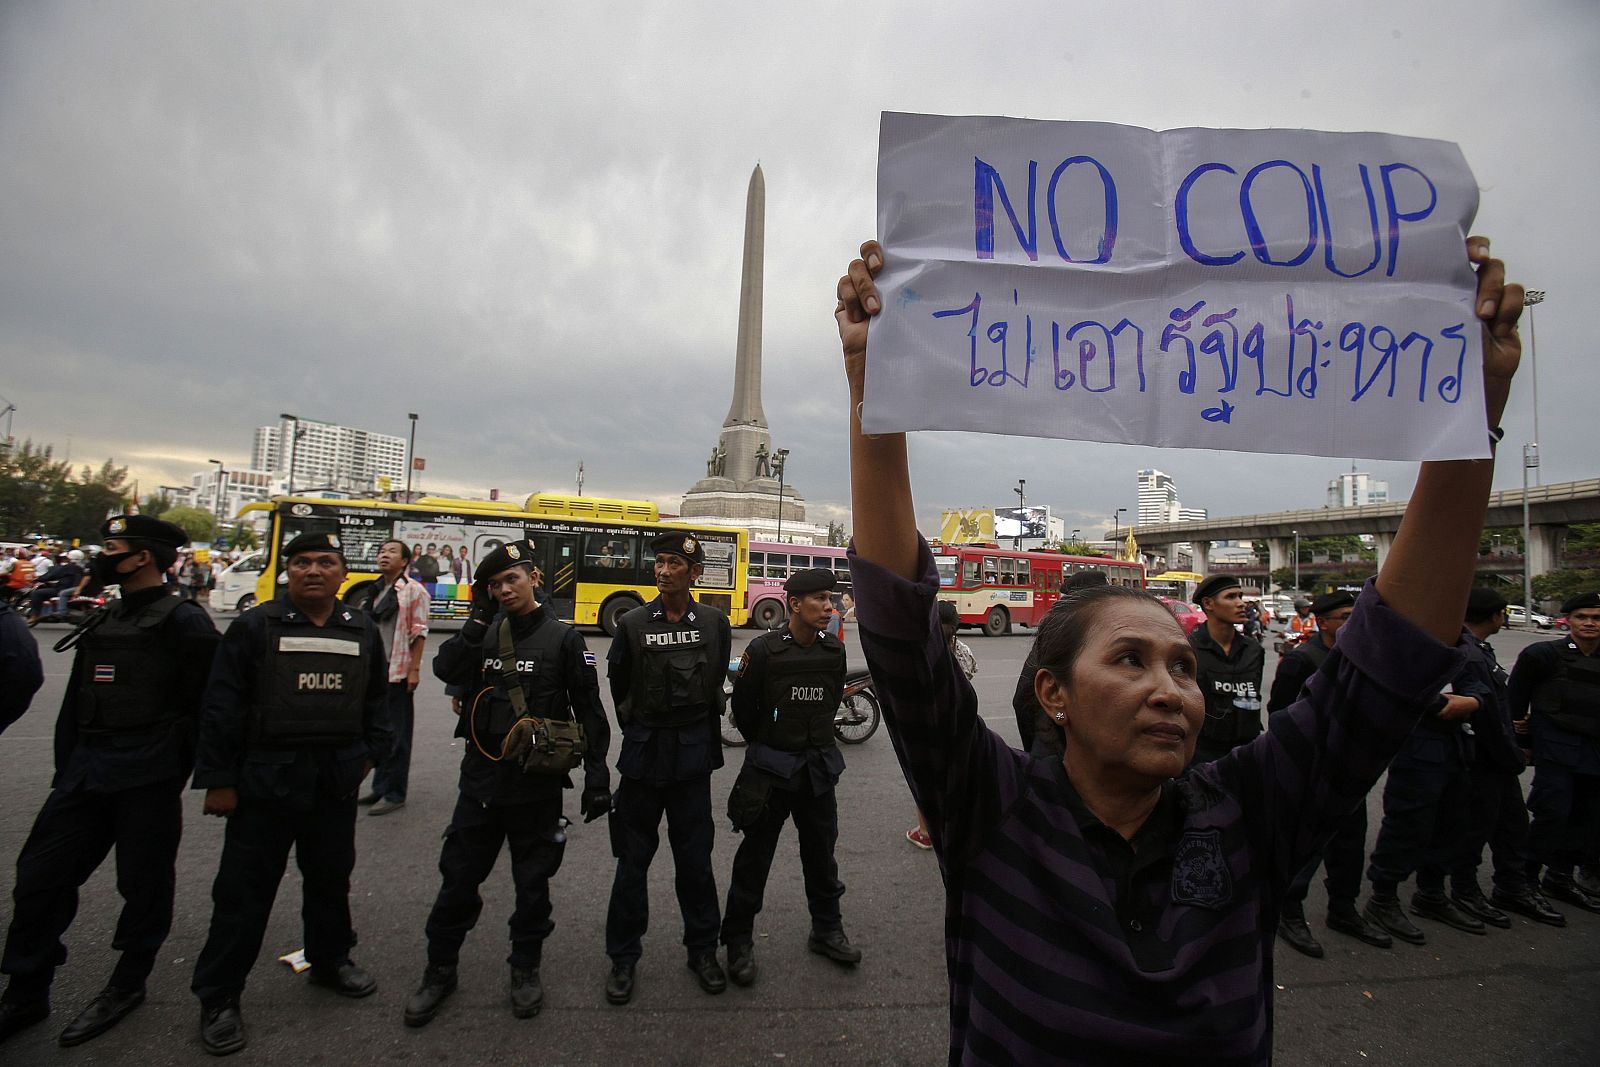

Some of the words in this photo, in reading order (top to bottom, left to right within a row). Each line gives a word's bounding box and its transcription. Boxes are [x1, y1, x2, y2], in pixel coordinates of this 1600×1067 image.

[973, 155, 1119, 265] NO
[1174, 158, 1438, 278] COUP
[645, 629, 700, 648] POLICE
[483, 658, 535, 673] POCE
[297, 672, 343, 691] POLICE
[1215, 681, 1255, 693] POLICE
[791, 686, 824, 702] POLICE
